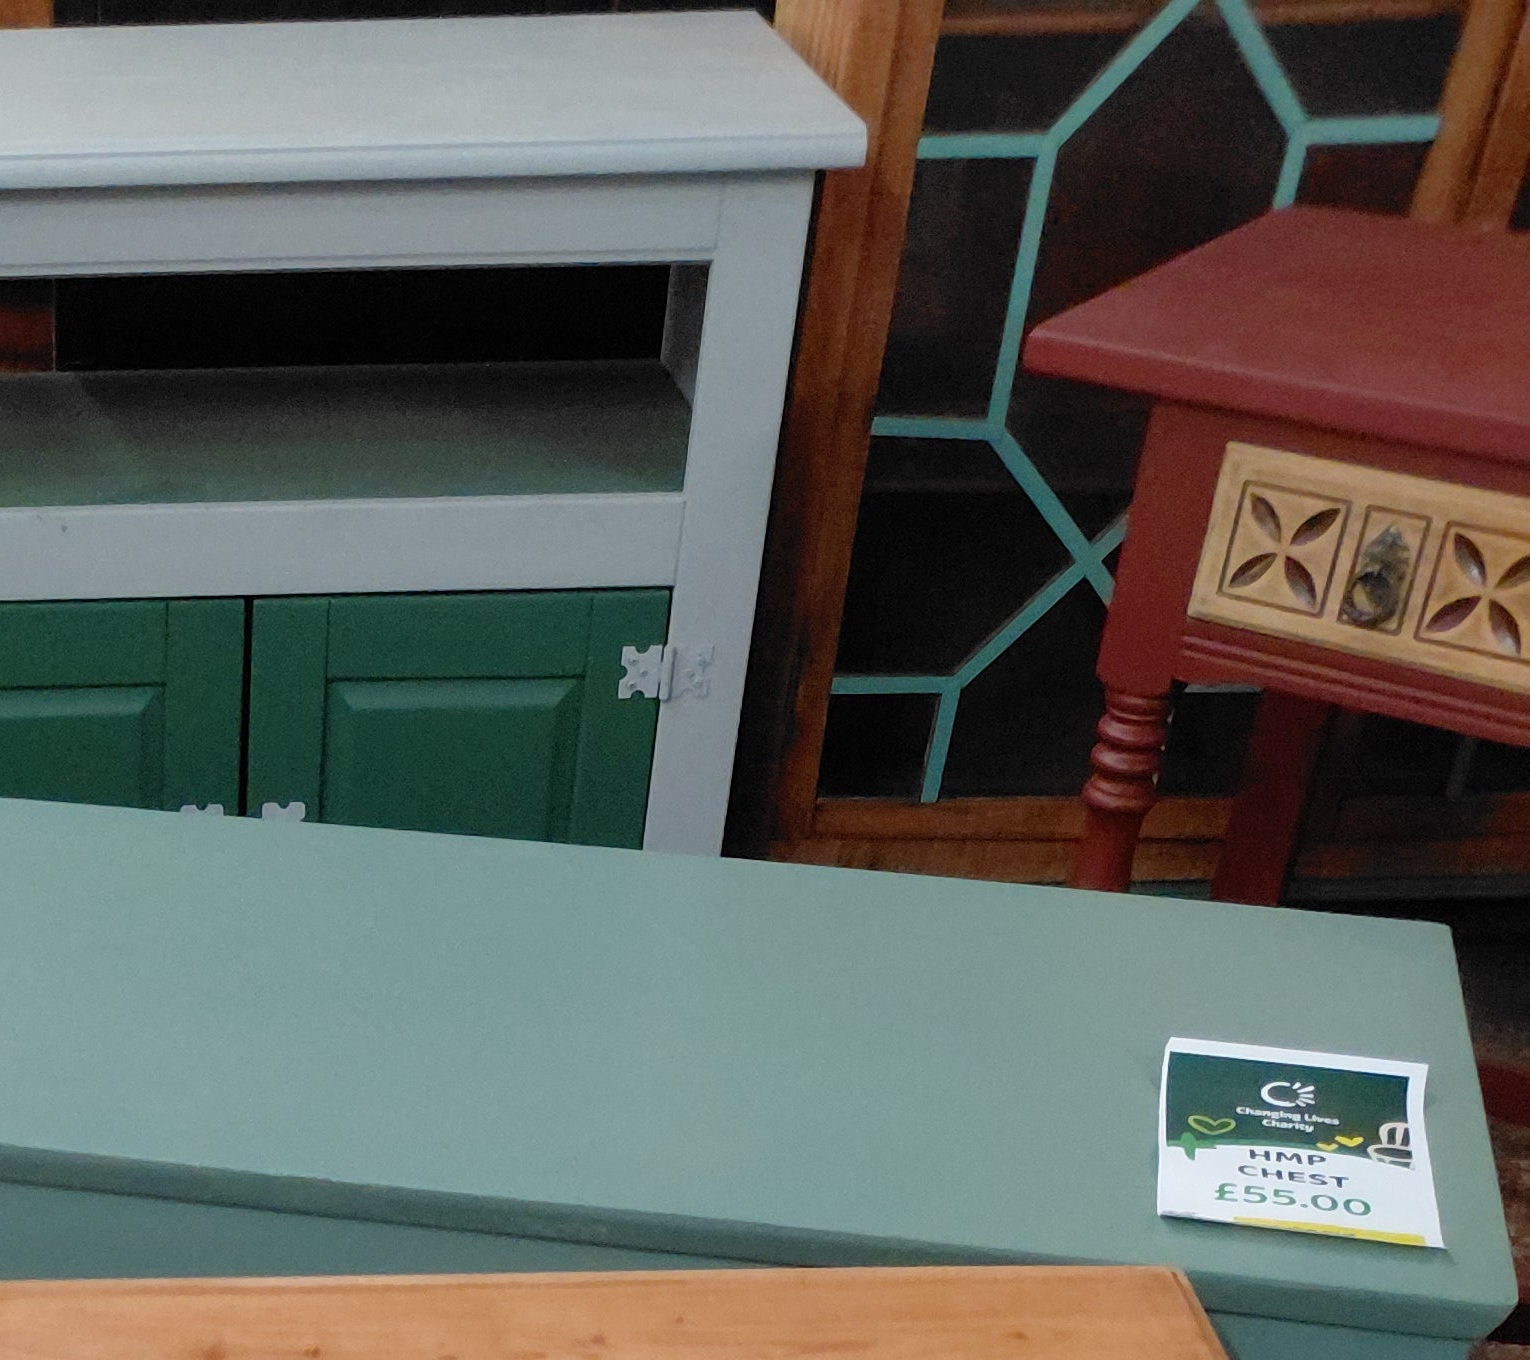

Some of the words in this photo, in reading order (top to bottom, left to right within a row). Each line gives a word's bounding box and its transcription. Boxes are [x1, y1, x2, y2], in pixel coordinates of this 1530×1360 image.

[1236, 1106, 1302, 1121] Changing
[1304, 1113, 1340, 1125] Lives
[1262, 1119, 1314, 1133] Charity
[1249, 1149, 1326, 1166] HMP
[1238, 1165, 1349, 1188] CHEST
[1214, 1182, 1372, 1216] £55.00
